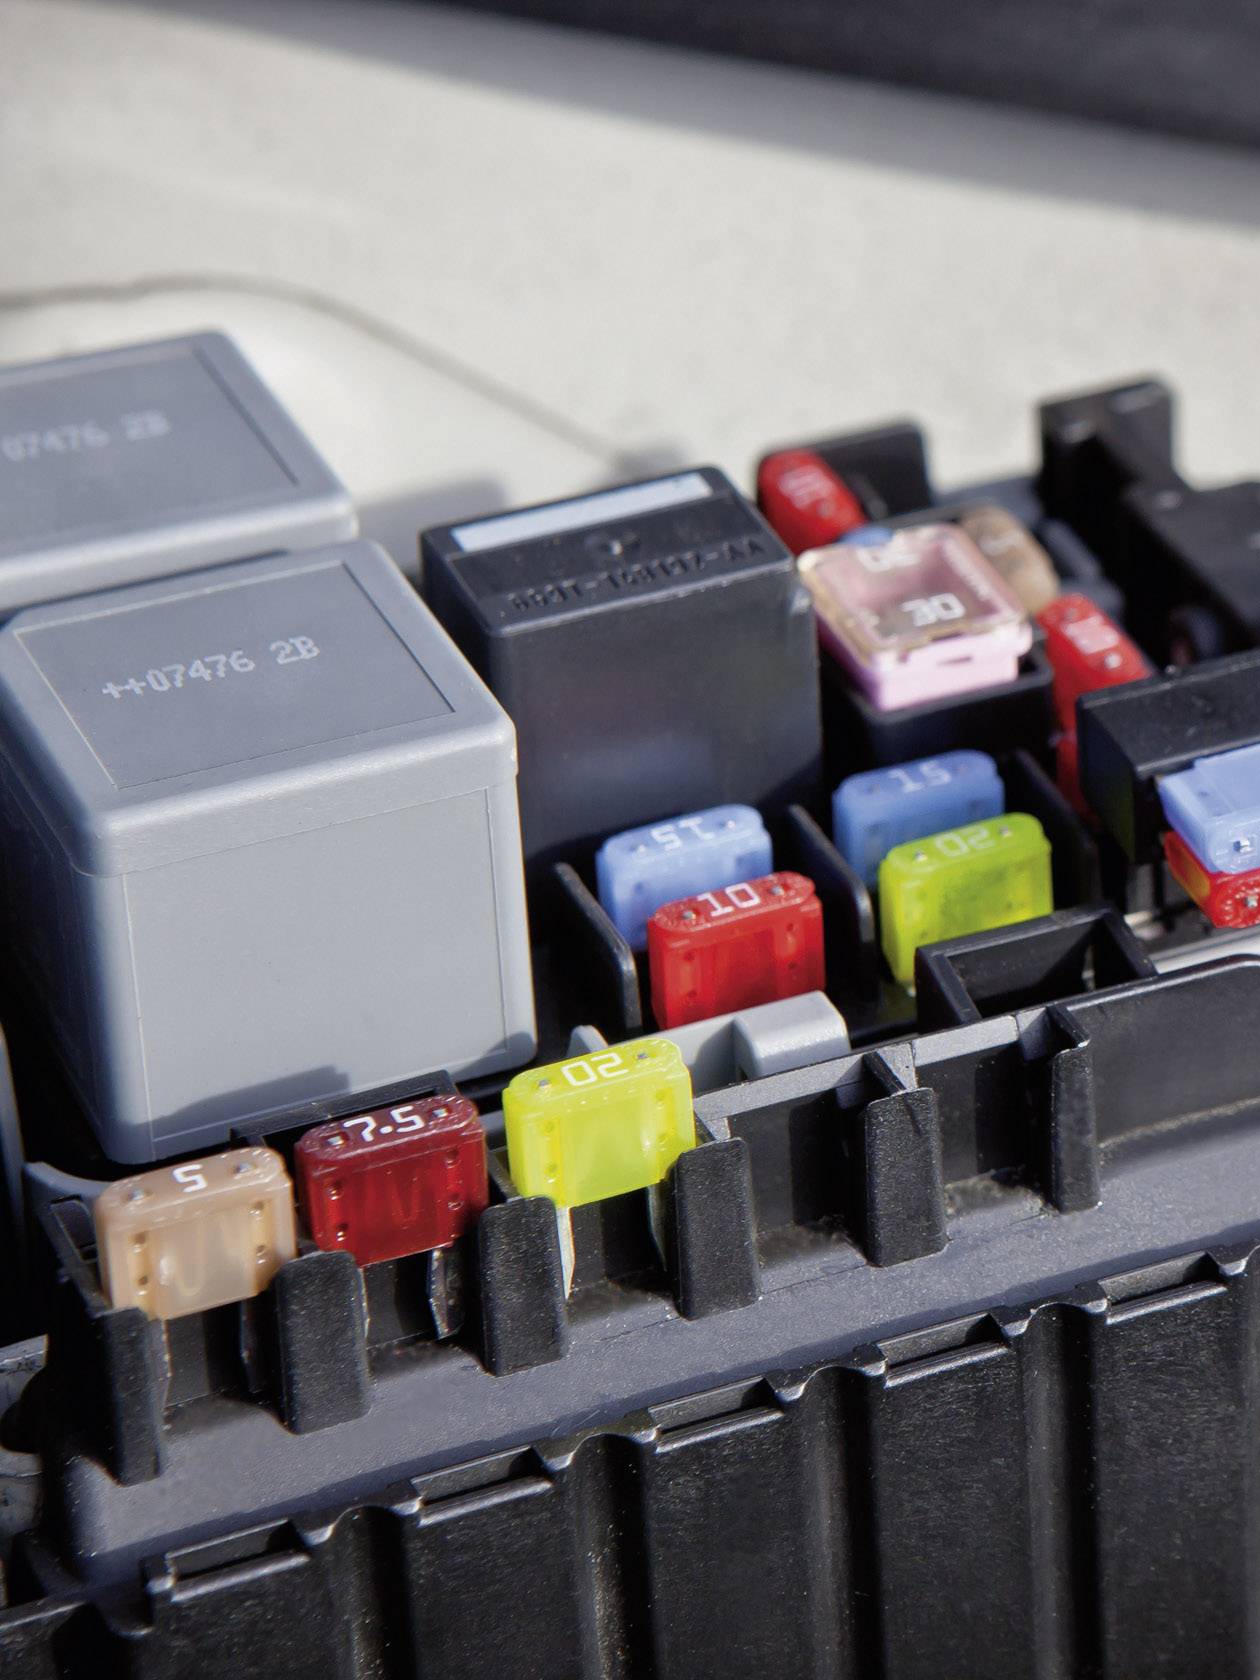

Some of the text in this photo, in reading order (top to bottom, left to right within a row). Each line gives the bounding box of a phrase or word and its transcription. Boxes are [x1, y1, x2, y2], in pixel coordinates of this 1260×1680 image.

[900, 592, 966, 627] 30
[102, 635, 321, 698] ++07476 2B
[887, 760, 952, 794] 15
[651, 815, 718, 852] 15
[933, 824, 997, 858] 20
[697, 881, 762, 917] 10
[560, 1052, 630, 1087] 20
[342, 1104, 426, 1143] 7.5
[171, 1163, 208, 1194] 5
